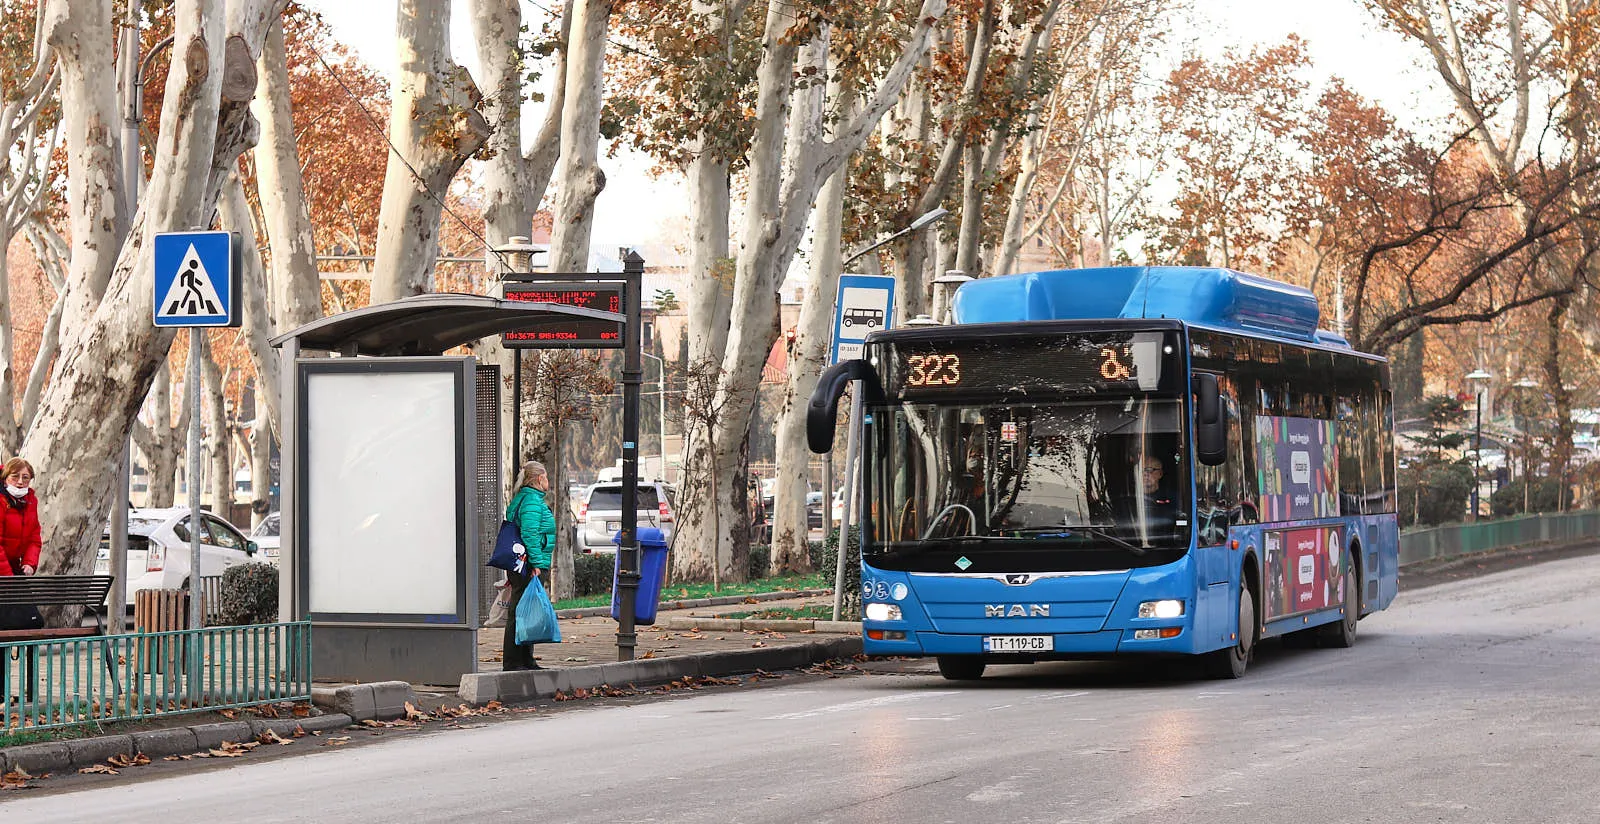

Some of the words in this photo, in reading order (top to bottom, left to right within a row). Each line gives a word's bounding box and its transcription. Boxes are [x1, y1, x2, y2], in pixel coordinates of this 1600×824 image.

[908, 354, 960, 386] 323
[984, 604, 1050, 618] MAN
[991, 637, 1045, 650] TT-119-CB
